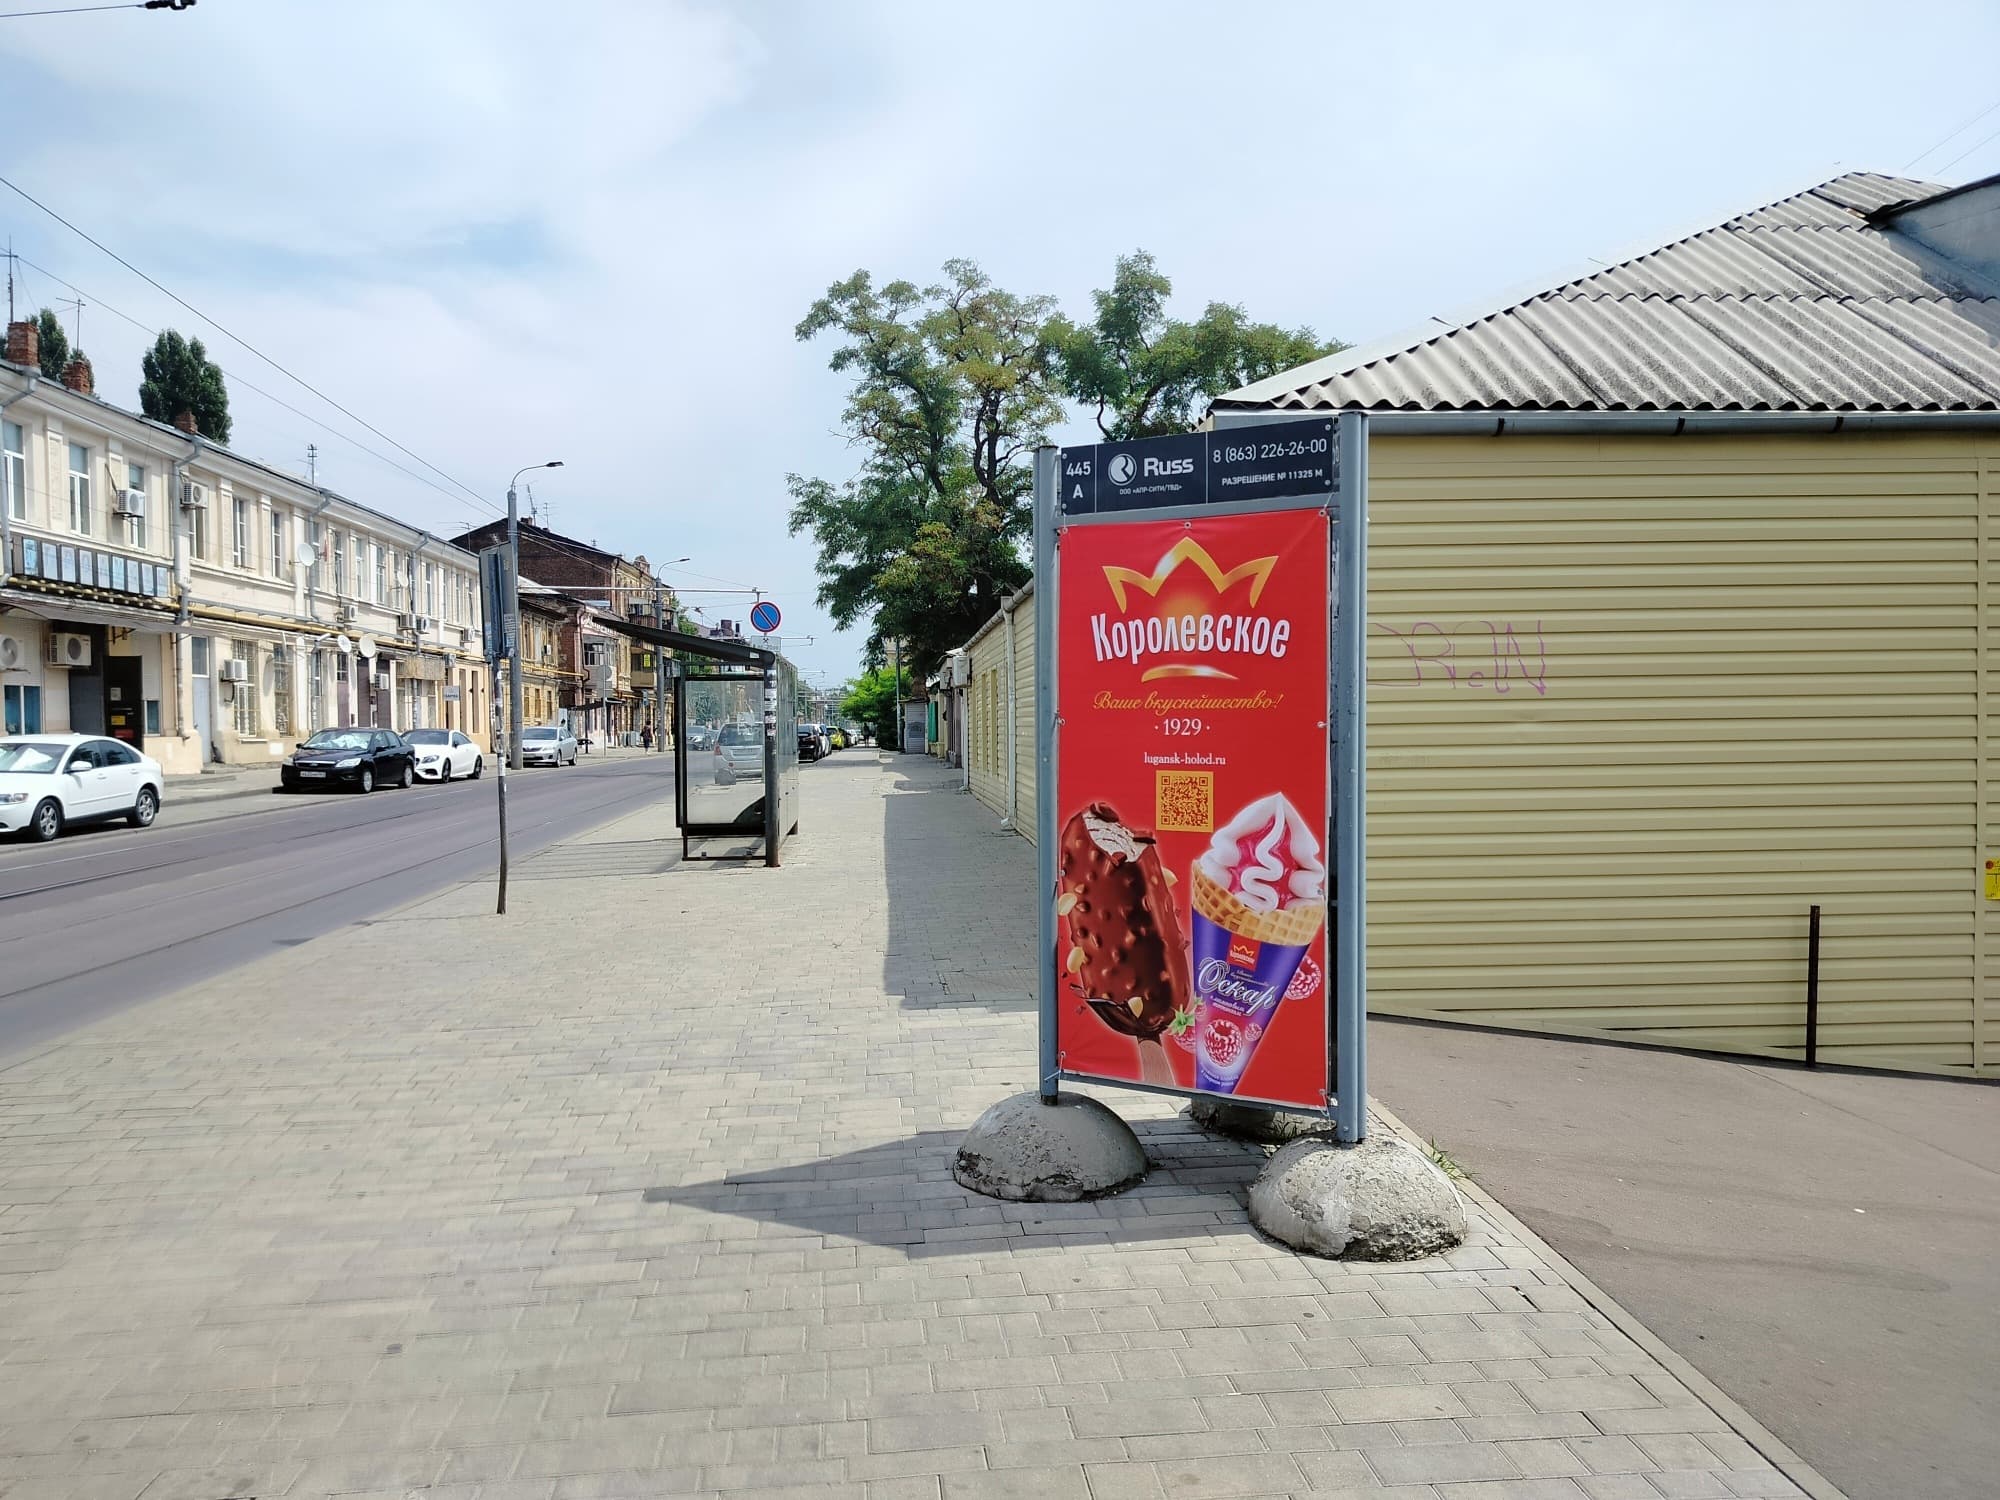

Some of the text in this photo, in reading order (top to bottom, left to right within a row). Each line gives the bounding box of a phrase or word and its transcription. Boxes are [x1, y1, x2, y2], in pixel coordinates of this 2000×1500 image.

[1213, 438, 1327, 463] 8 (863) 226-26-00
[1066, 461, 1091, 476] 445
[1143, 457, 1194, 477] Russ
[1222, 473, 1276, 486] РАЗРЕШЕНИЕ
[1288, 469, 1313, 480] 11325
[1090, 613, 1290, 664] Королевское
[1092, 689, 1284, 716] Ваше вкуснейшество!
[1144, 752, 1226, 766] lugansk-holod.ru
[1198, 957, 1277, 1016] Оскар
